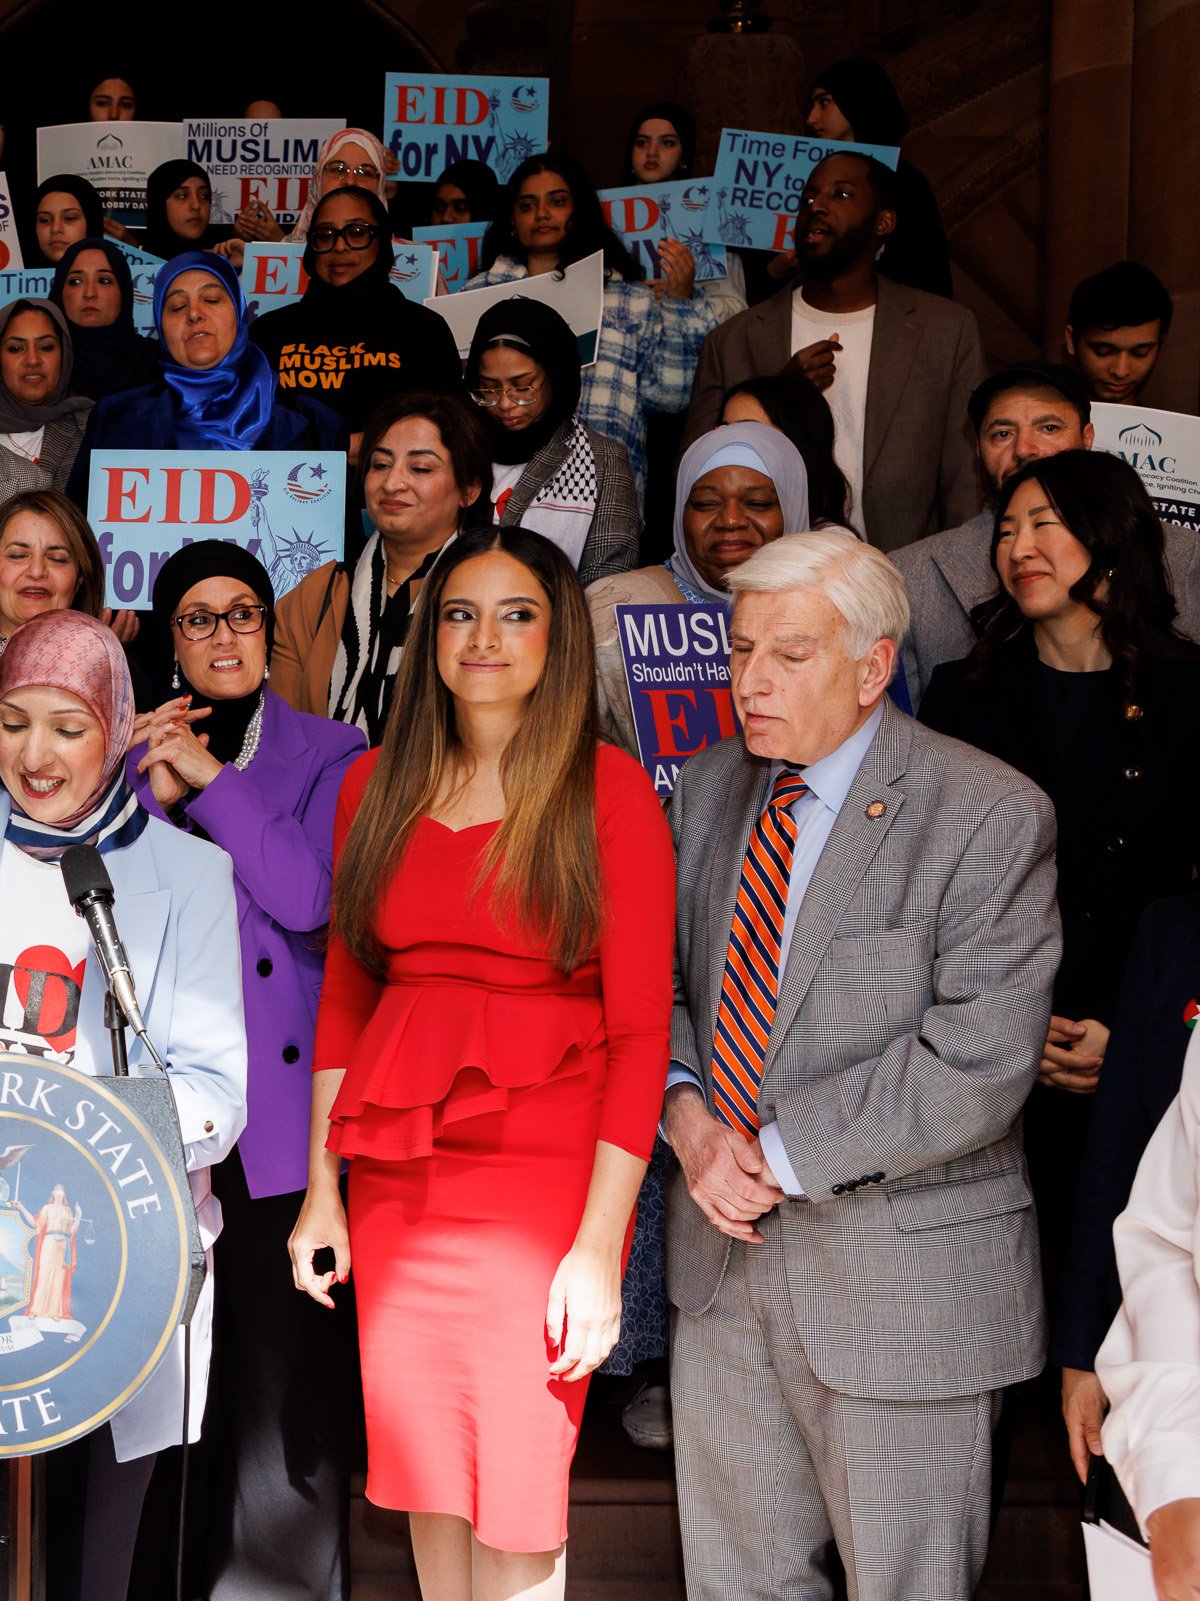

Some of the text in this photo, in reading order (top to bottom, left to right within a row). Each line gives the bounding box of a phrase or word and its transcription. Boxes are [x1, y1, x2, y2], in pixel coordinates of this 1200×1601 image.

[393, 85, 490, 125] EID
[188, 123, 269, 138] Millions Of
[389, 129, 438, 177] for
[726, 133, 786, 158] Time
[87, 156, 133, 169] AMAC
[207, 165, 238, 176] NEED
[734, 158, 805, 191] NY to
[120, 191, 147, 199] STATE
[280, 342, 367, 356] BLACK
[279, 352, 401, 371] MUSLIMS
[279, 370, 345, 389] NOW
[1103, 450, 1176, 474] MAC
[1156, 483, 1186, 494] Igniting
[1166, 476, 1198, 486] Coalition
[98, 468, 251, 524] EID
[1152, 501, 1196, 517] STATE
[623, 612, 733, 657] MUSL
[633, 662, 705, 683] Shouldn't
[64, 1100, 162, 1220] STATE
